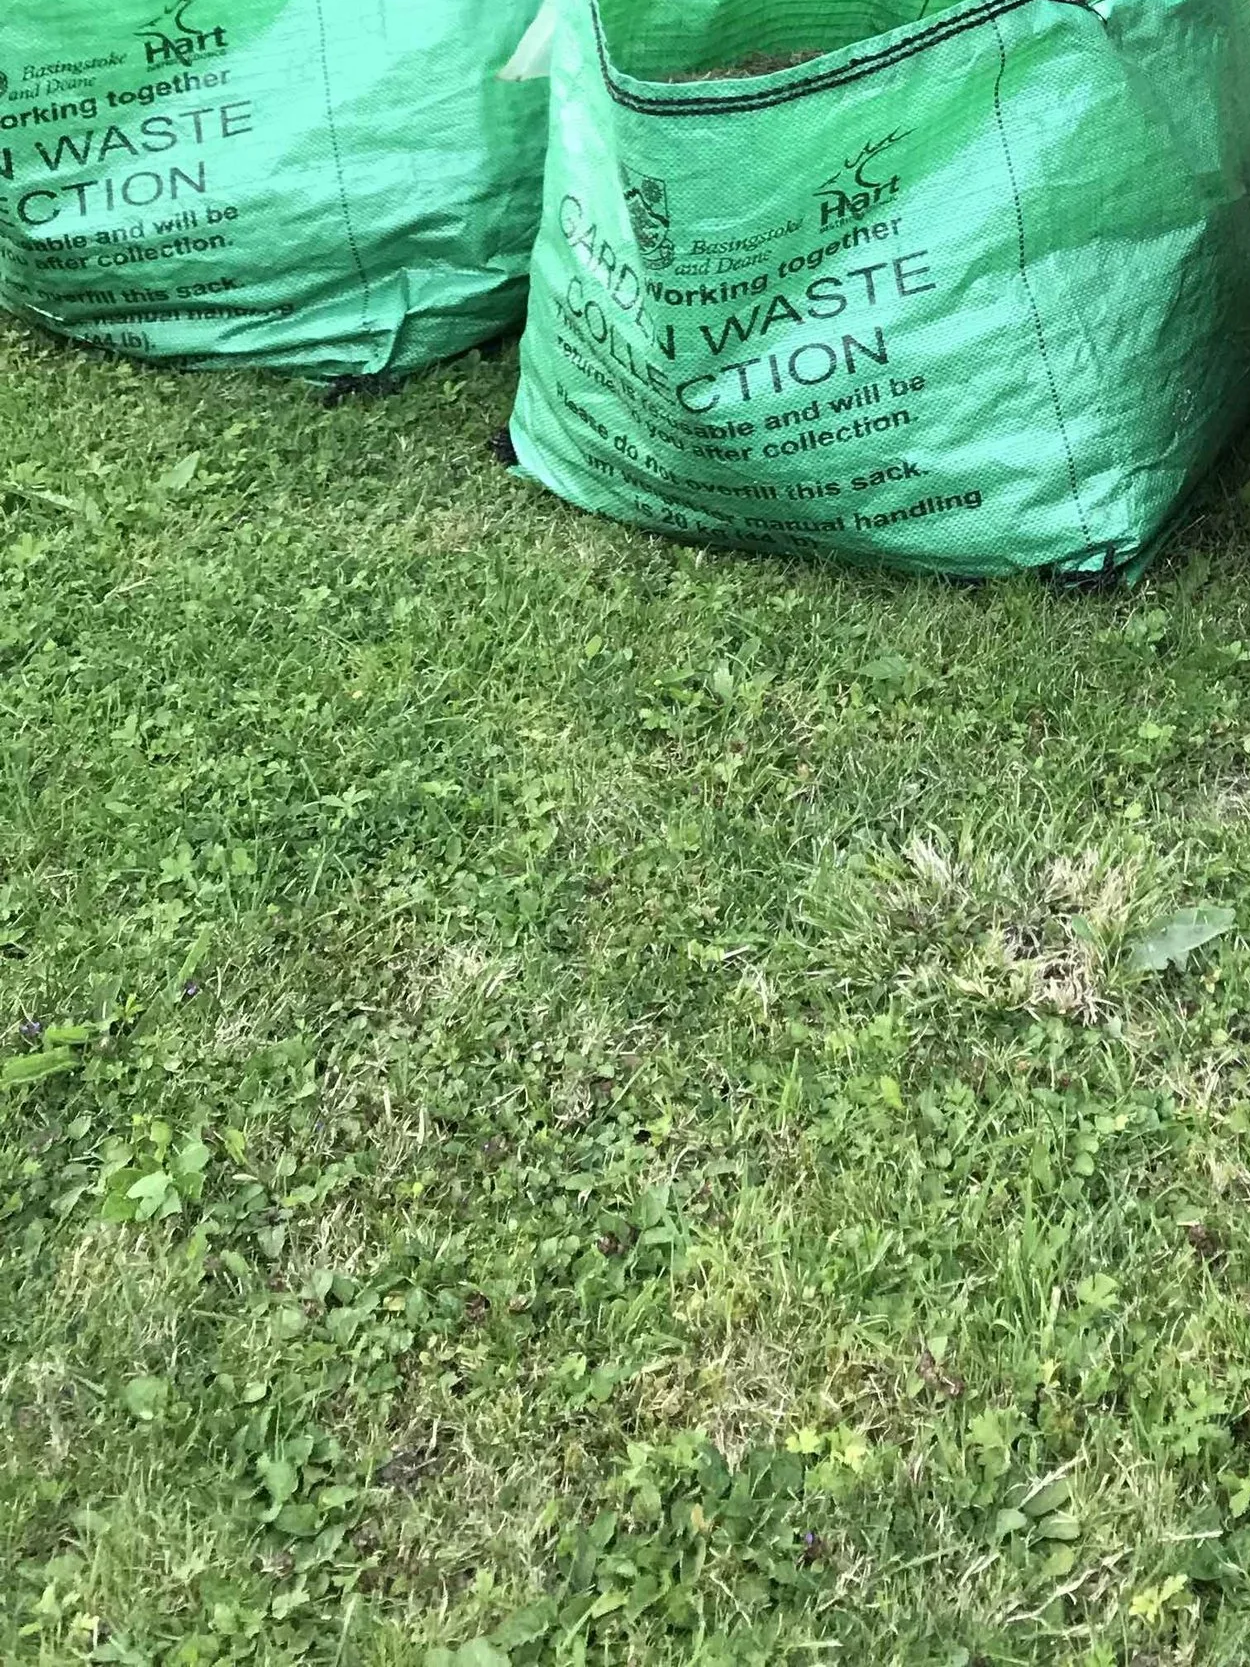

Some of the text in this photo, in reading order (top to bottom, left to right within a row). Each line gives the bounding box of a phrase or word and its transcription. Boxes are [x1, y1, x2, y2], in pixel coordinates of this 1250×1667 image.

[23, 52, 127, 81] Basingstoke
[144, 26, 229, 64] Hart
[0, 69, 231, 130] orking together
[8, 76, 97, 102] and Deane
[35, 100, 253, 172] WASTE
[820, 175, 900, 226] Hart
[96, 221, 145, 245] and
[153, 210, 198, 235] will
[206, 204, 238, 224] be
[691, 218, 804, 254] Basingstoke
[36, 254, 89, 272] after
[98, 233, 234, 269] collection.
[645, 217, 902, 307] Working together
[675, 250, 772, 276] and Deane
[122, 286, 169, 304] this
[176, 275, 245, 300] sack.
[700, 249, 937, 356] WASTE
[764, 401, 820, 431] and
[828, 386, 881, 414] will
[890, 375, 926, 397] be
[693, 444, 753, 462] after
[762, 408, 920, 459] collection.
[614, 434, 639, 461] do
[645, 454, 681, 484] not
[686, 478, 777, 502] overfill
[788, 480, 842, 502] this
[851, 460, 930, 492] sack.
[663, 507, 688, 530] 20
[745, 515, 845, 534] manual
[855, 489, 983, 531] handling
